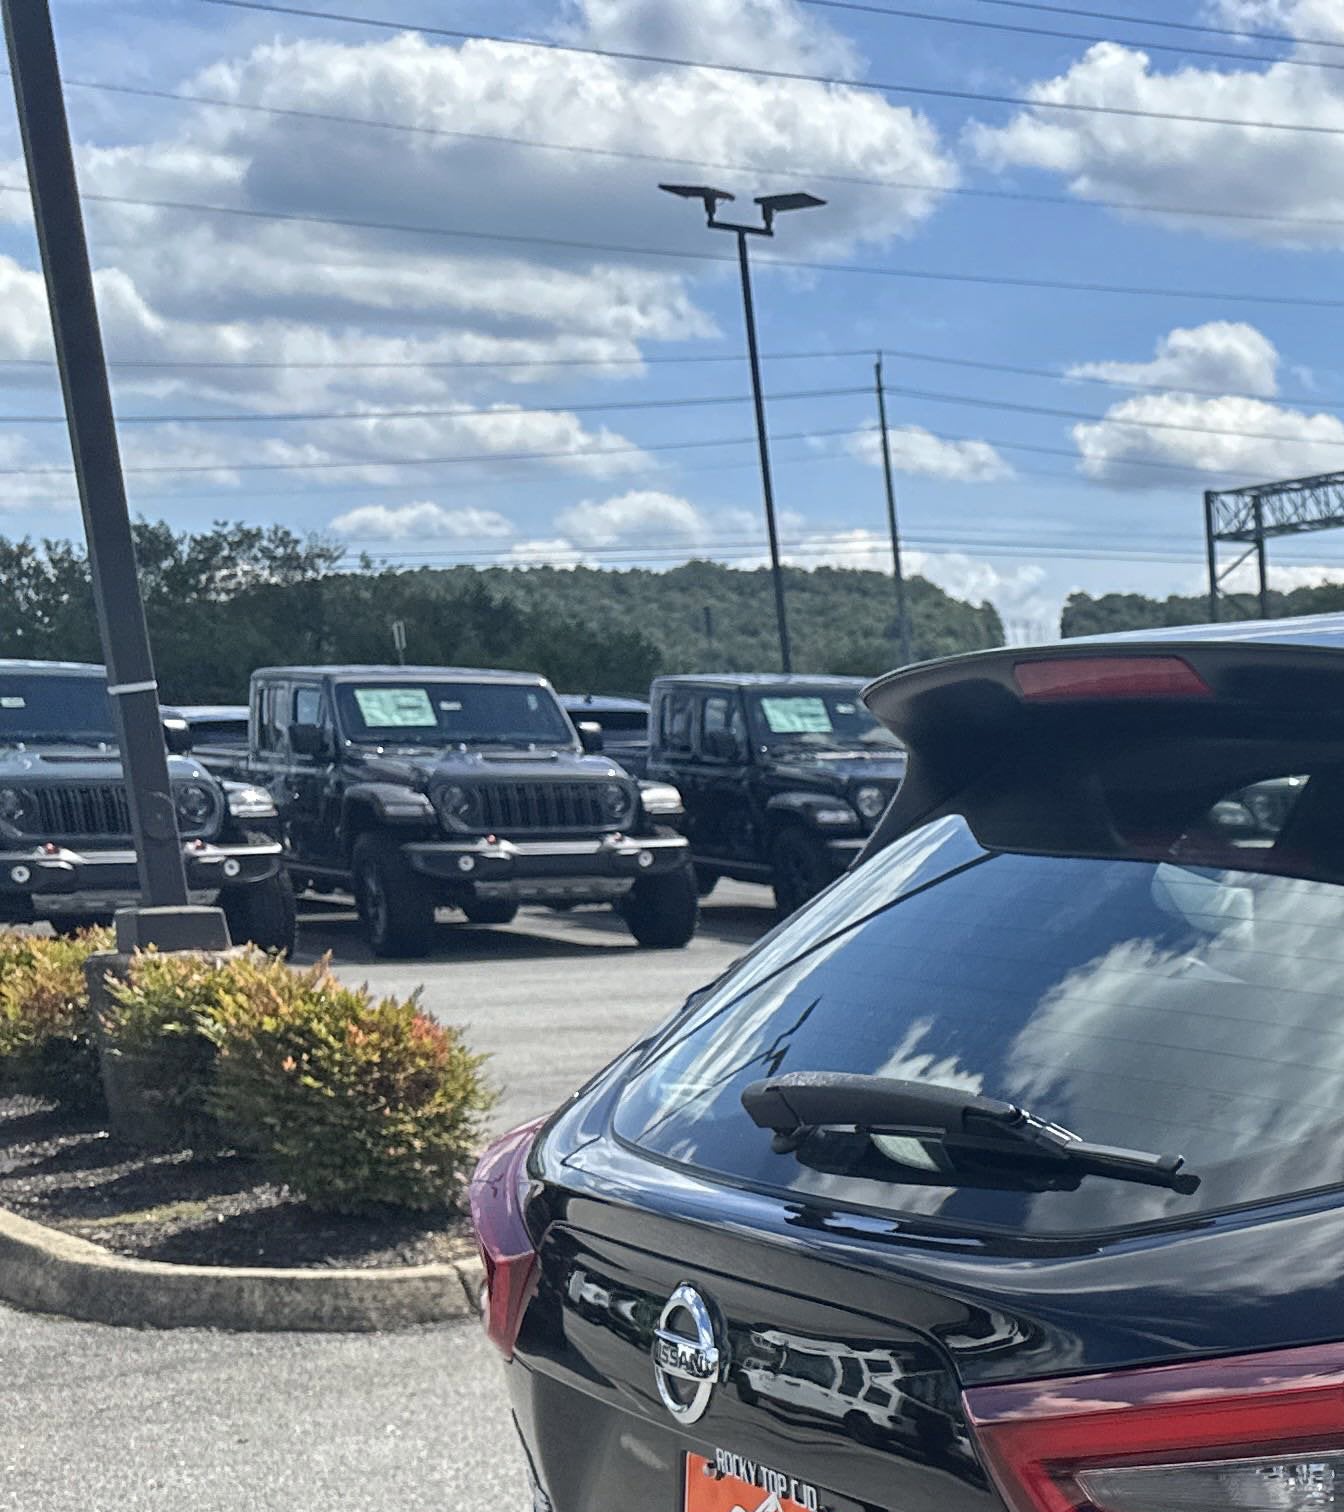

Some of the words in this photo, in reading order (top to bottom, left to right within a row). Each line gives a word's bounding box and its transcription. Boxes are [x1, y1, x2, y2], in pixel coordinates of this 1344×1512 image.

[715, 1447, 757, 1487] ROCKY
[759, 1466, 787, 1499] TOP
[791, 1479, 818, 1511] CJD
